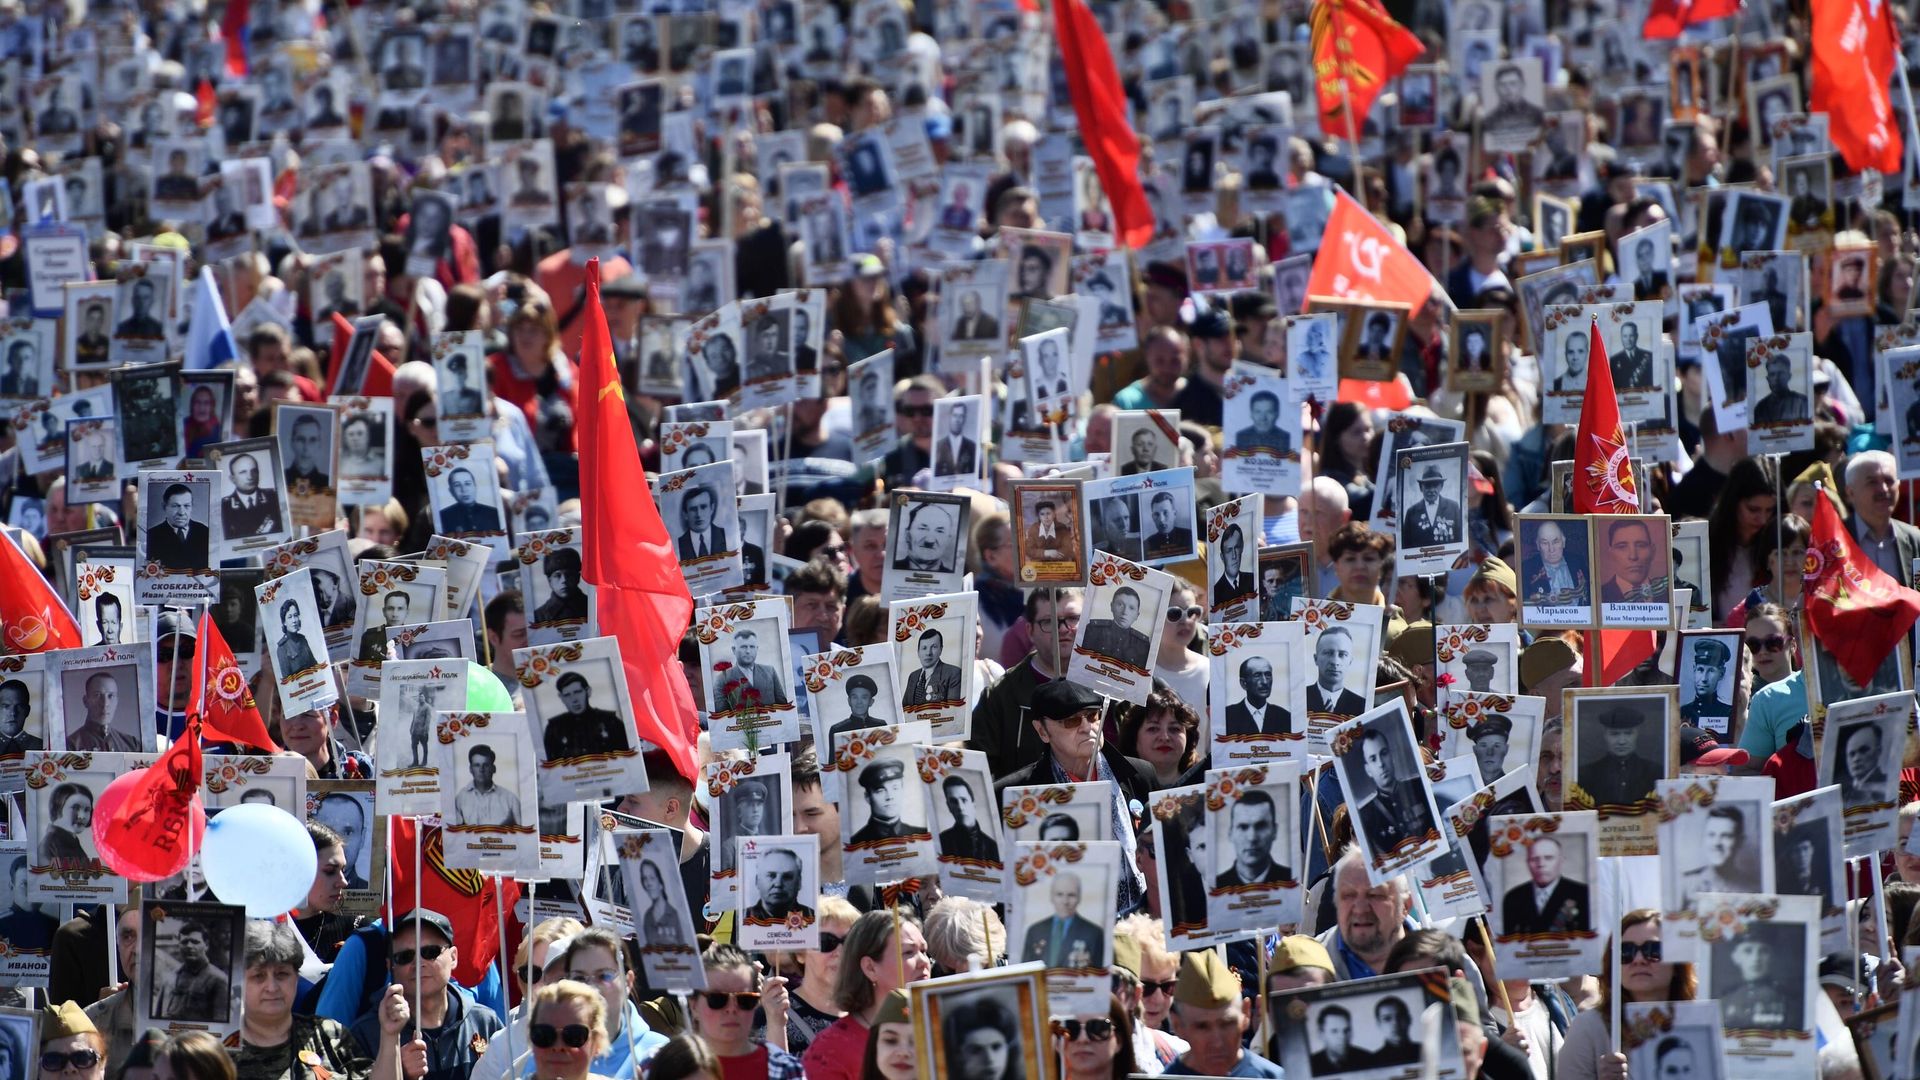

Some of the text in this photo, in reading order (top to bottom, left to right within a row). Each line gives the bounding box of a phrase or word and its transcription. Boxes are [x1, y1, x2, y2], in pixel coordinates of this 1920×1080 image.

[151, 582, 205, 590] СКОБКАРЁВ
[1537, 607, 1579, 616] Марьясов
[1610, 603, 1664, 613] Владимиров
[8, 962, 47, 970] ИВАНОВ
